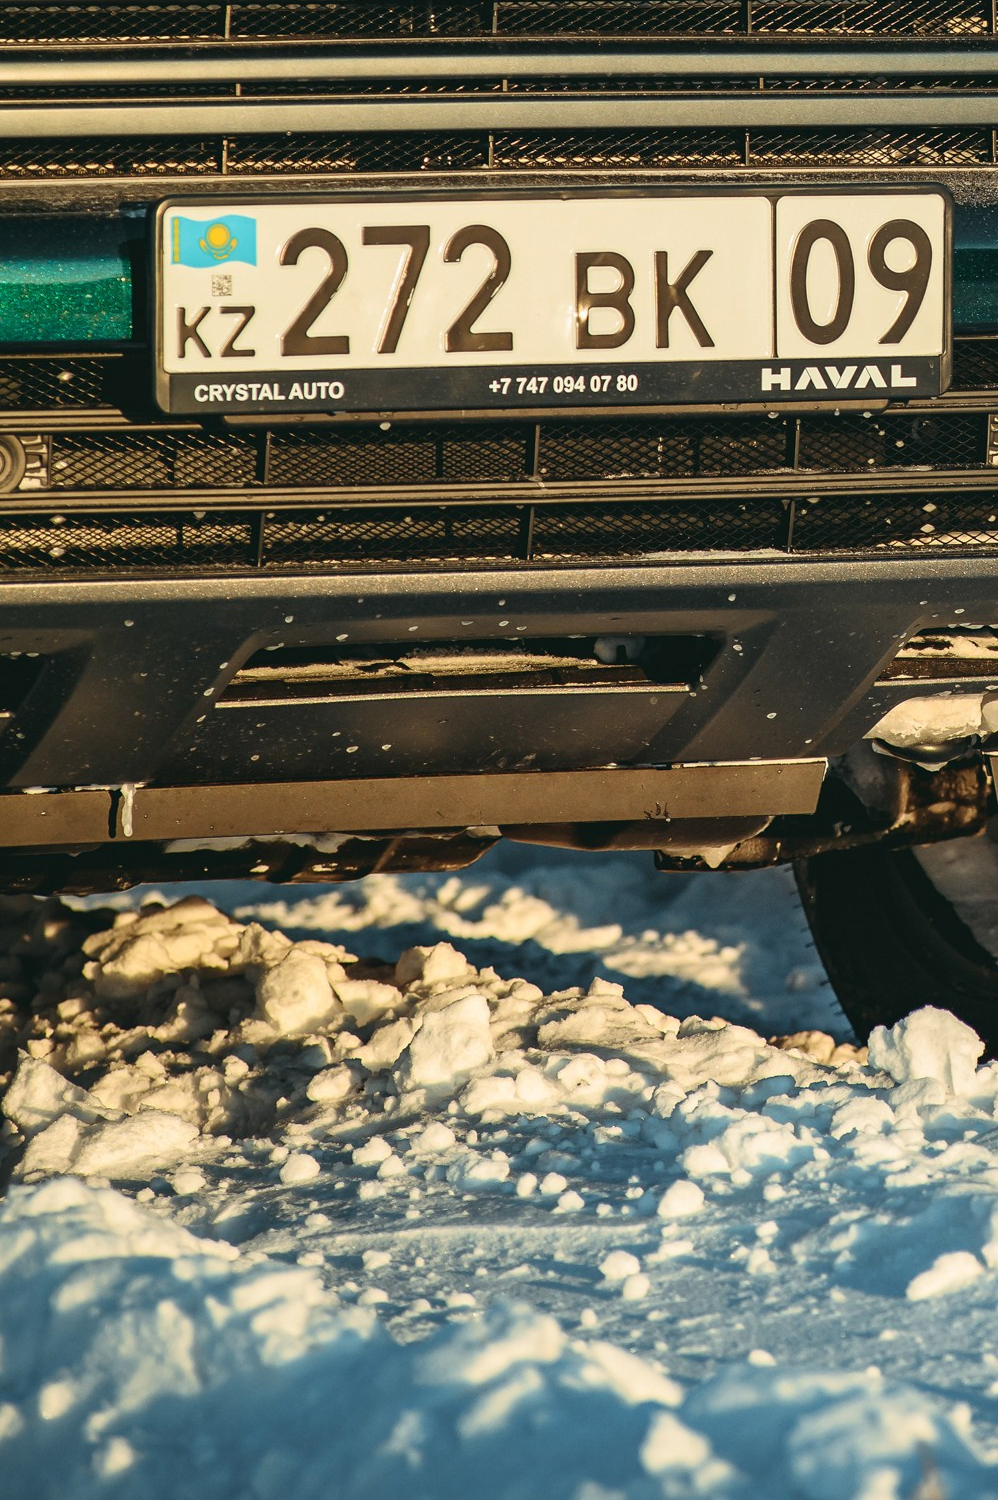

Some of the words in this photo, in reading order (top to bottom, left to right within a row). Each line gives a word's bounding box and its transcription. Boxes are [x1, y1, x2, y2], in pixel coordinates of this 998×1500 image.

[278, 223, 515, 358] 272
[574, 249, 716, 351] BK
[788, 217, 933, 346] 09
[174, 304, 256, 360] KZ
[194, 383, 286, 402] CRYSTAL
[288, 381, 345, 400] AUTO
[488, 377, 512, 395] +7
[515, 376, 549, 394] 747
[552, 375, 586, 393] 094
[589, 375, 612, 392] 07
[616, 374, 638, 392] 80
[760, 364, 918, 392] HAVAL
